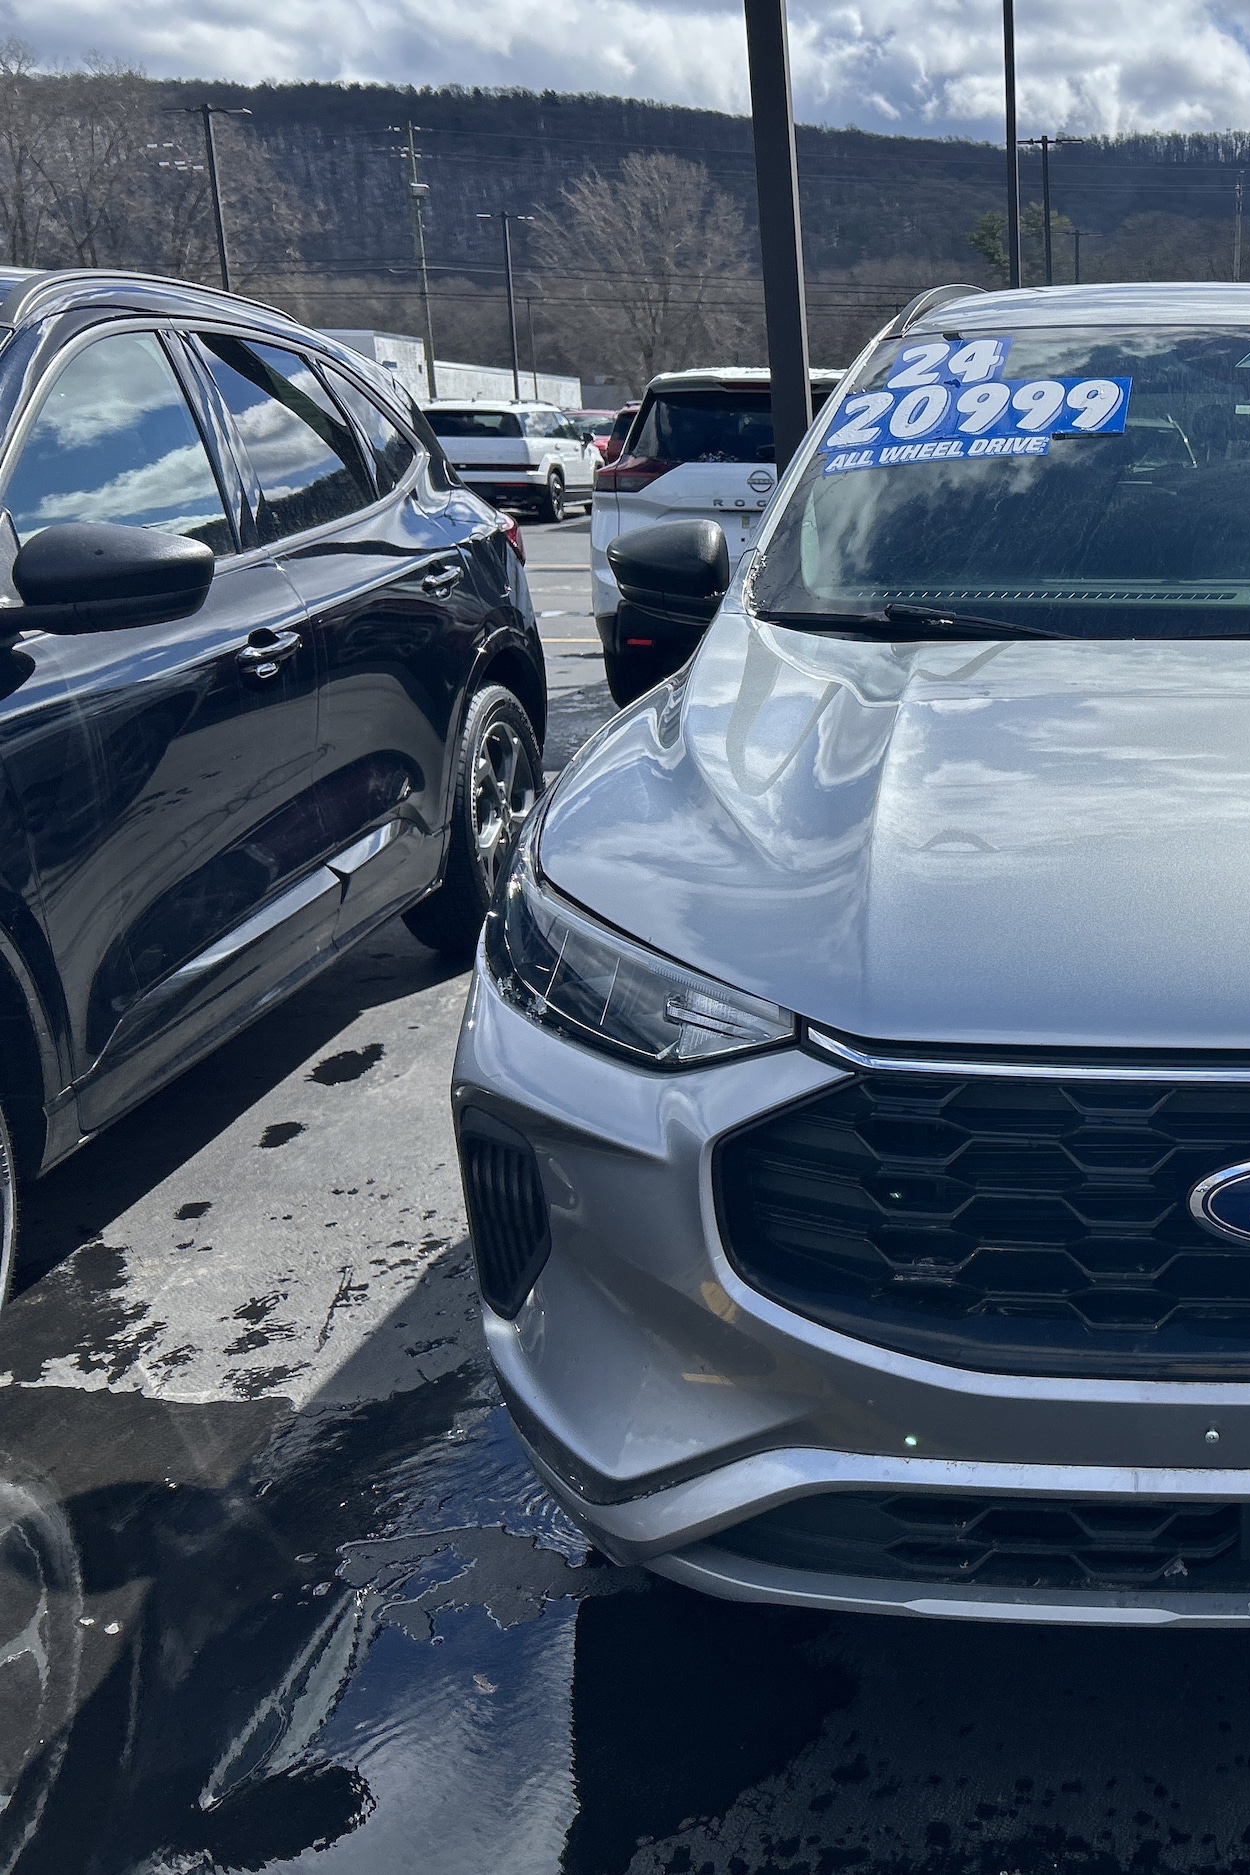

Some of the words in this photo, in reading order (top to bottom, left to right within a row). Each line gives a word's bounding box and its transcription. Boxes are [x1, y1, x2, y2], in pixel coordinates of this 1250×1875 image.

[887, 339, 1004, 389] 24
[826, 379, 1124, 447] 20999
[825, 450, 874, 473] ALL
[879, 440, 964, 465] WHEEL
[967, 436, 1050, 456] DRIVE
